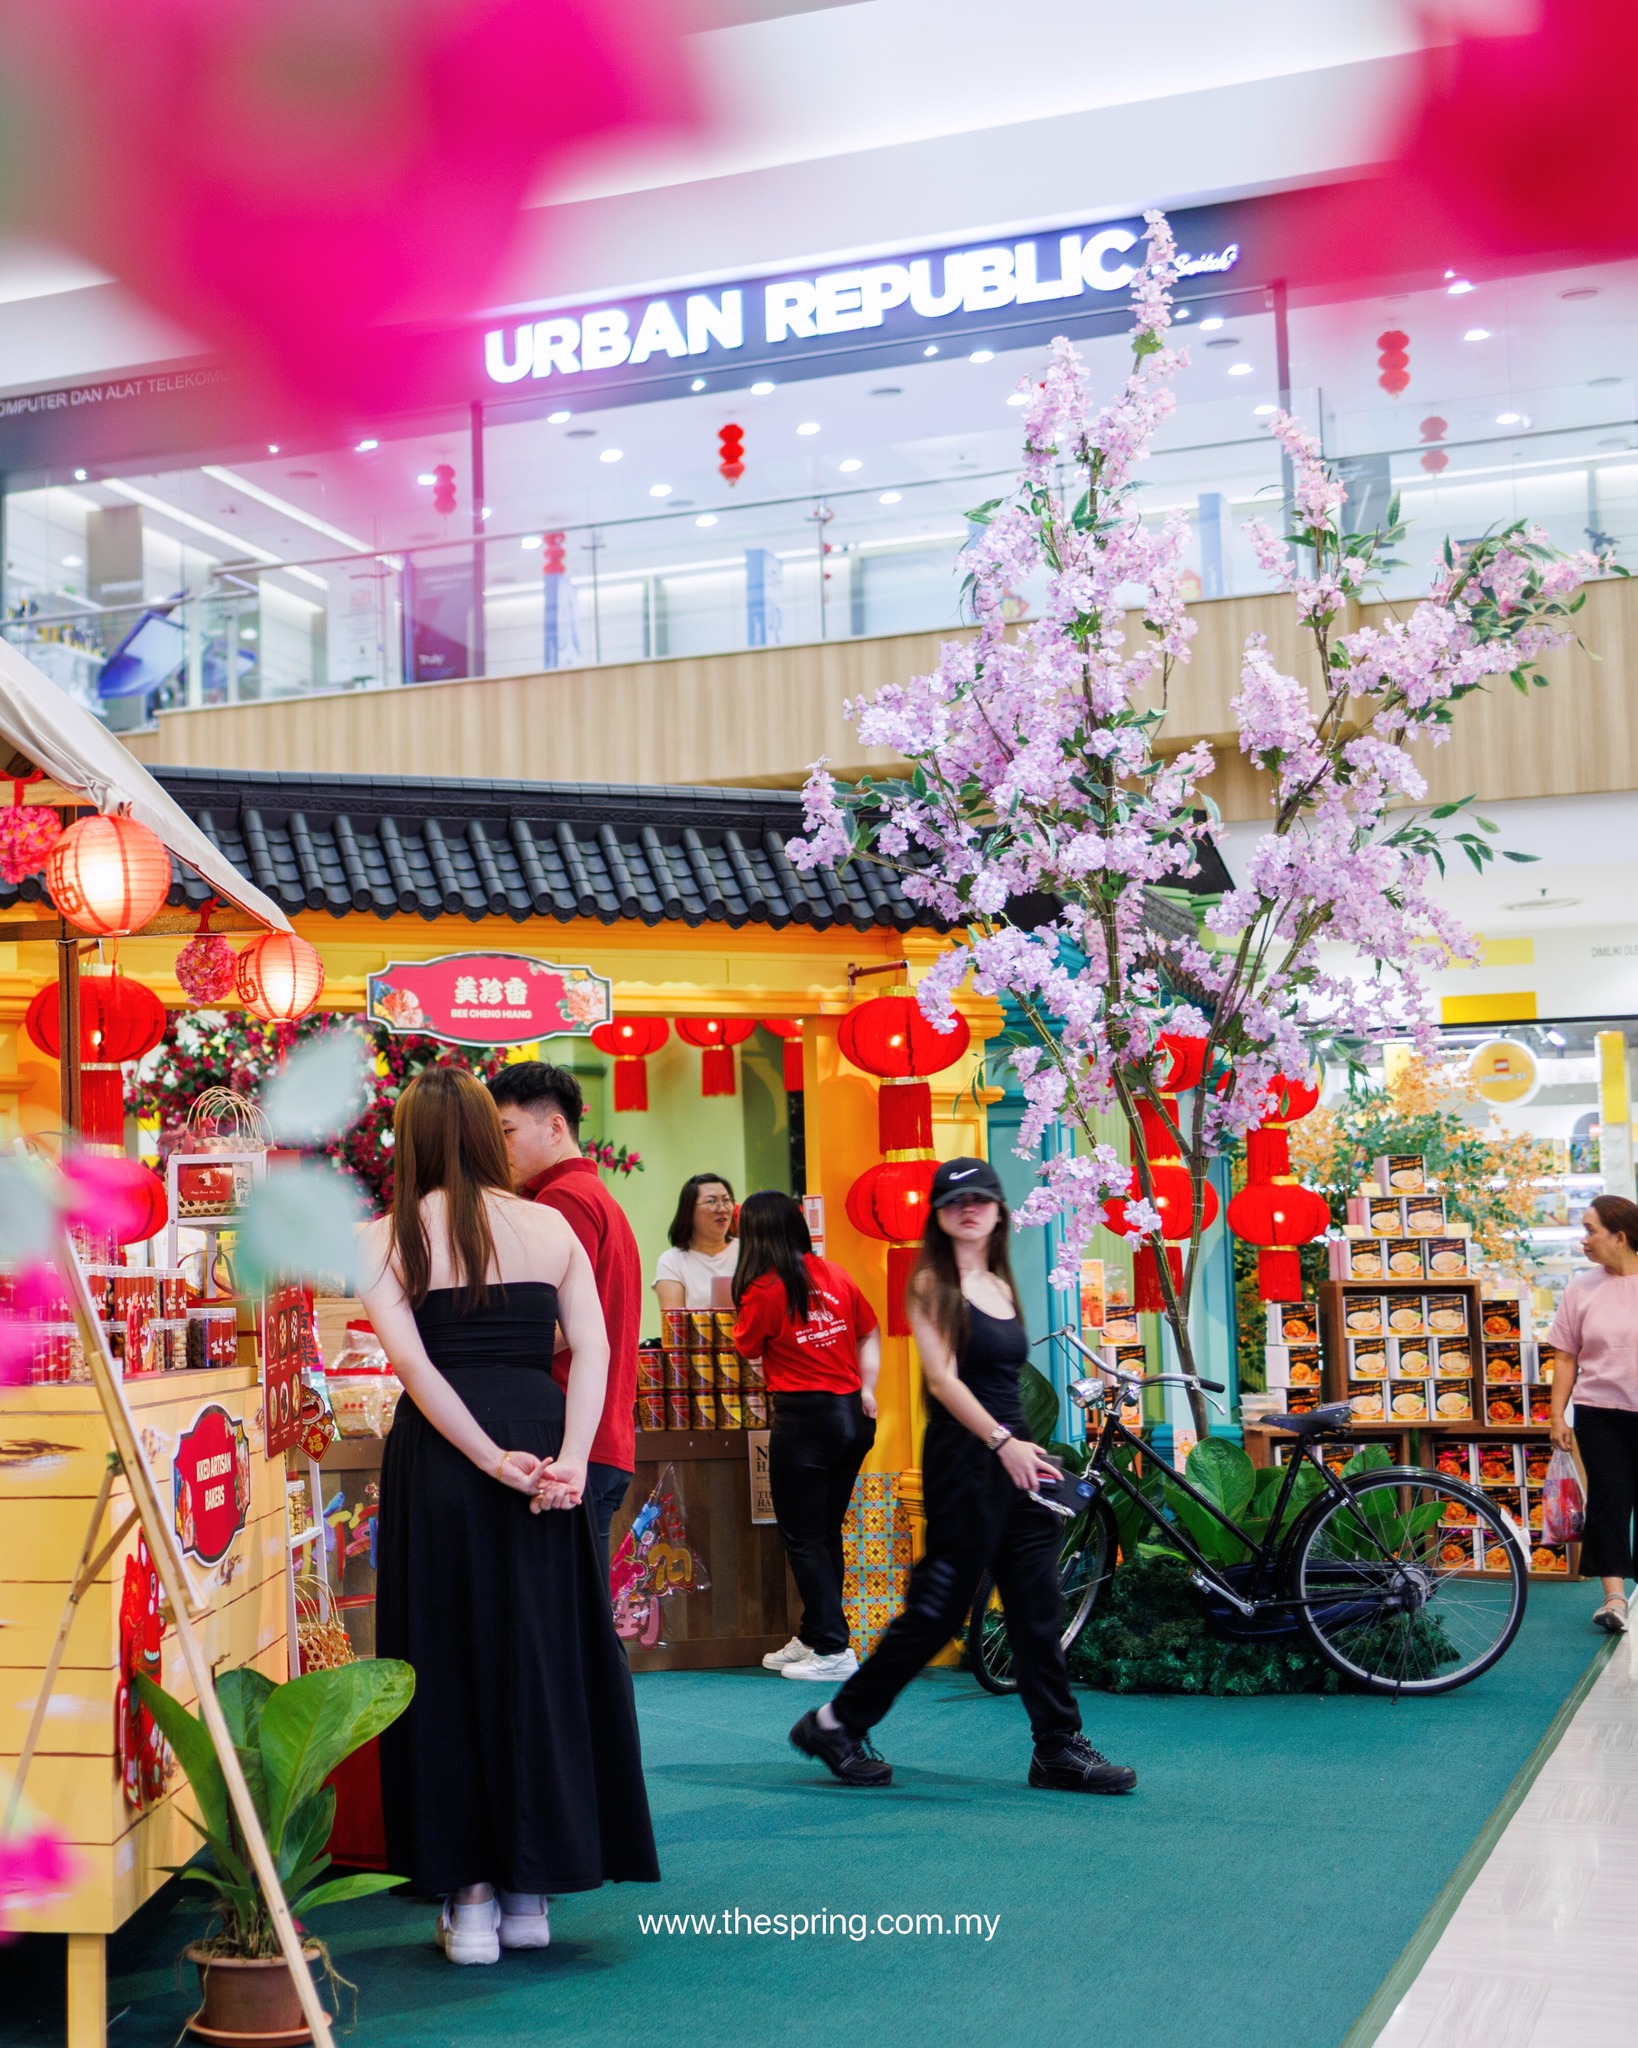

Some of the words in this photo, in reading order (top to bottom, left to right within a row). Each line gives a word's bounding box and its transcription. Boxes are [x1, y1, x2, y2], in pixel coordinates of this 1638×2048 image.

[484, 288, 744, 385] URBAN
[764, 228, 1139, 342] REPUBLIC
[71, 388, 104, 407] DAN
[105, 381, 144, 400] ALAT
[147, 369, 242, 394] TELEKOMU
[454, 976, 528, 1005] 美珍香
[450, 1008, 469, 1019] BEE
[469, 1009, 502, 1019] CHENG
[502, 1009, 532, 1020] HIANG
[210, 1451, 232, 1478] ARTISAN
[205, 1484, 225, 1511] BAKERS
